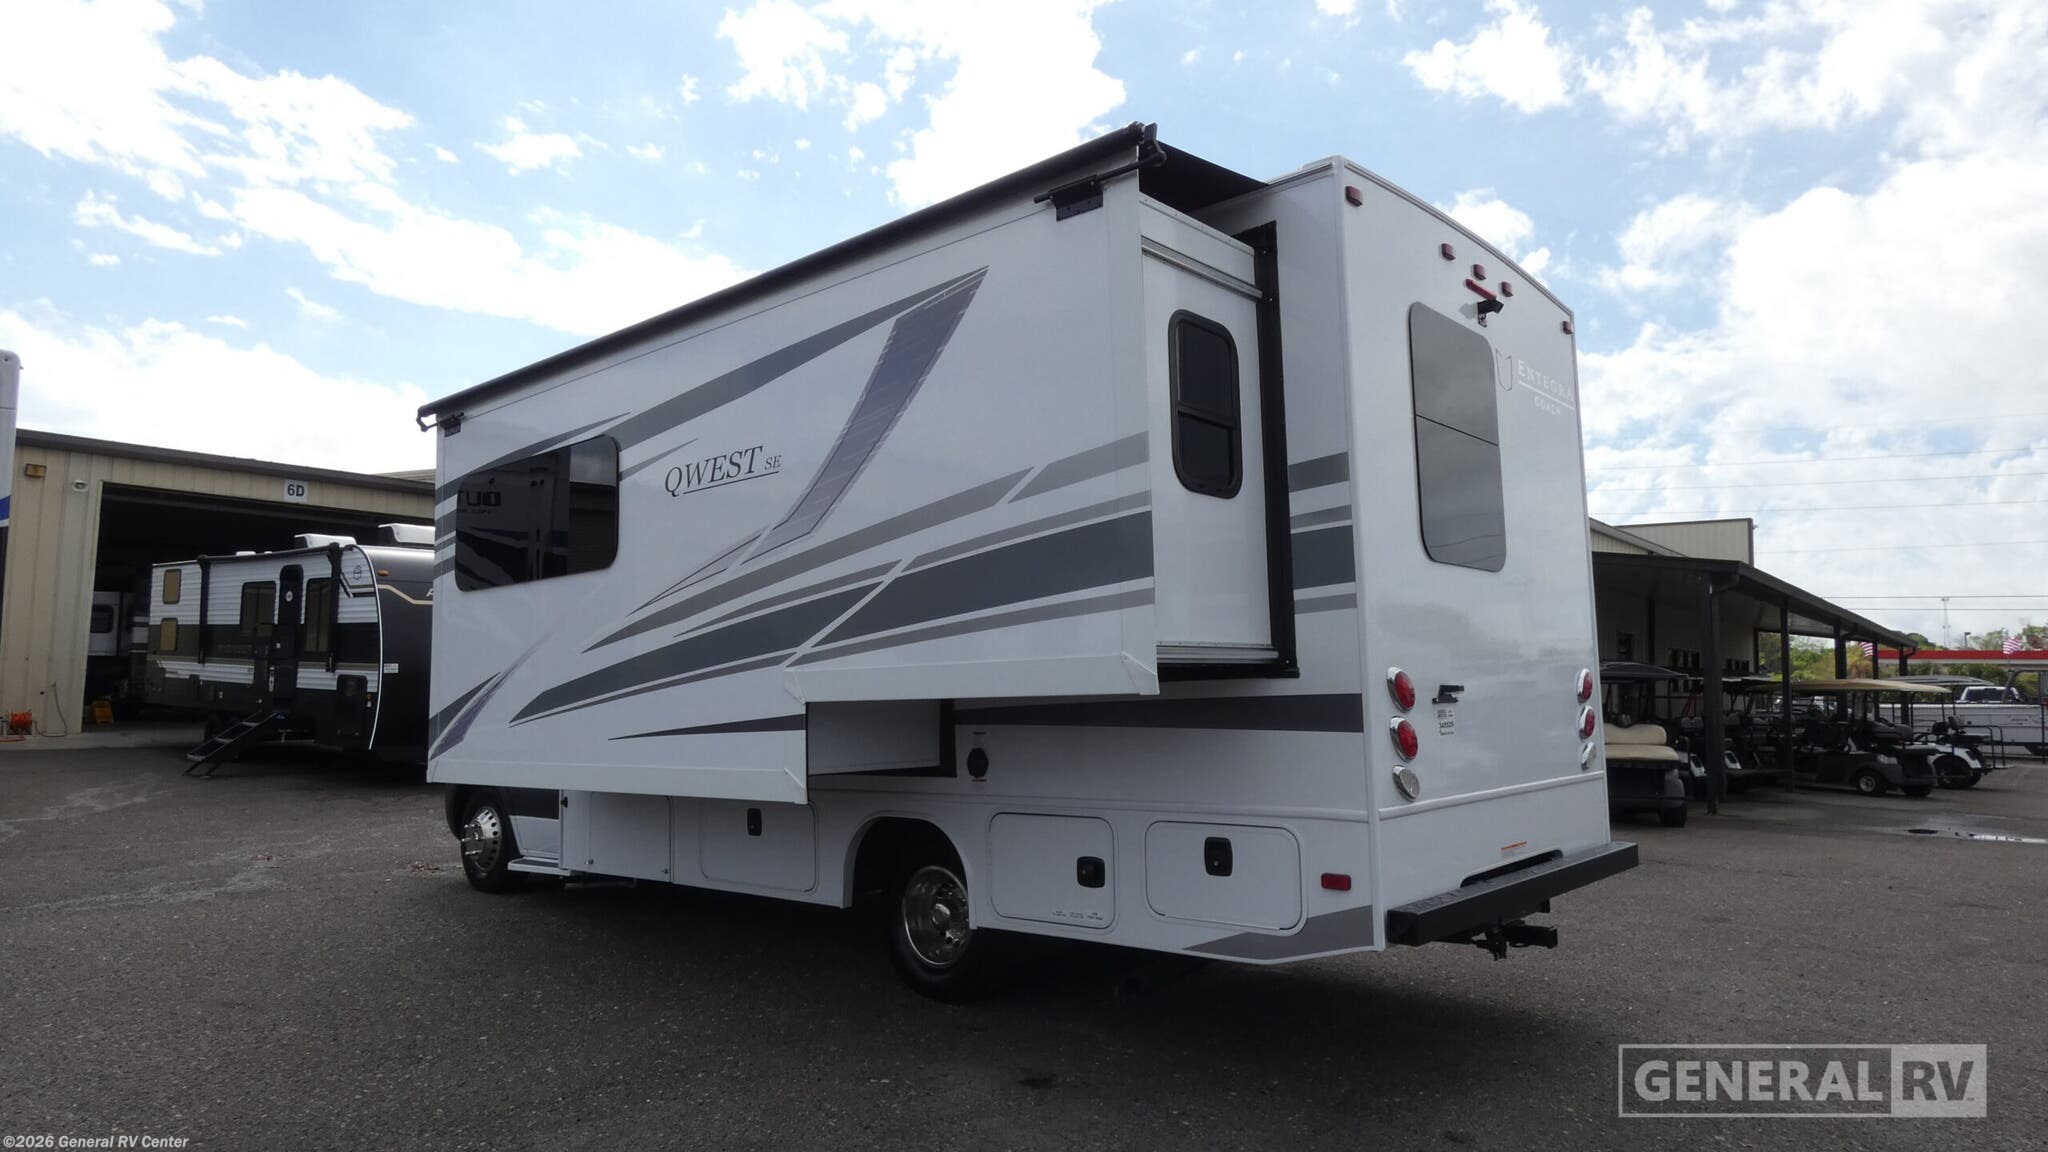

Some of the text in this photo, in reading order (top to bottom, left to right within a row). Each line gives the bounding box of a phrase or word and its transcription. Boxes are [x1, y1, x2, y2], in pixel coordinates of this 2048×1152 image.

[664, 445, 782, 497] QWEST SE
[287, 483, 305, 497] 6D
